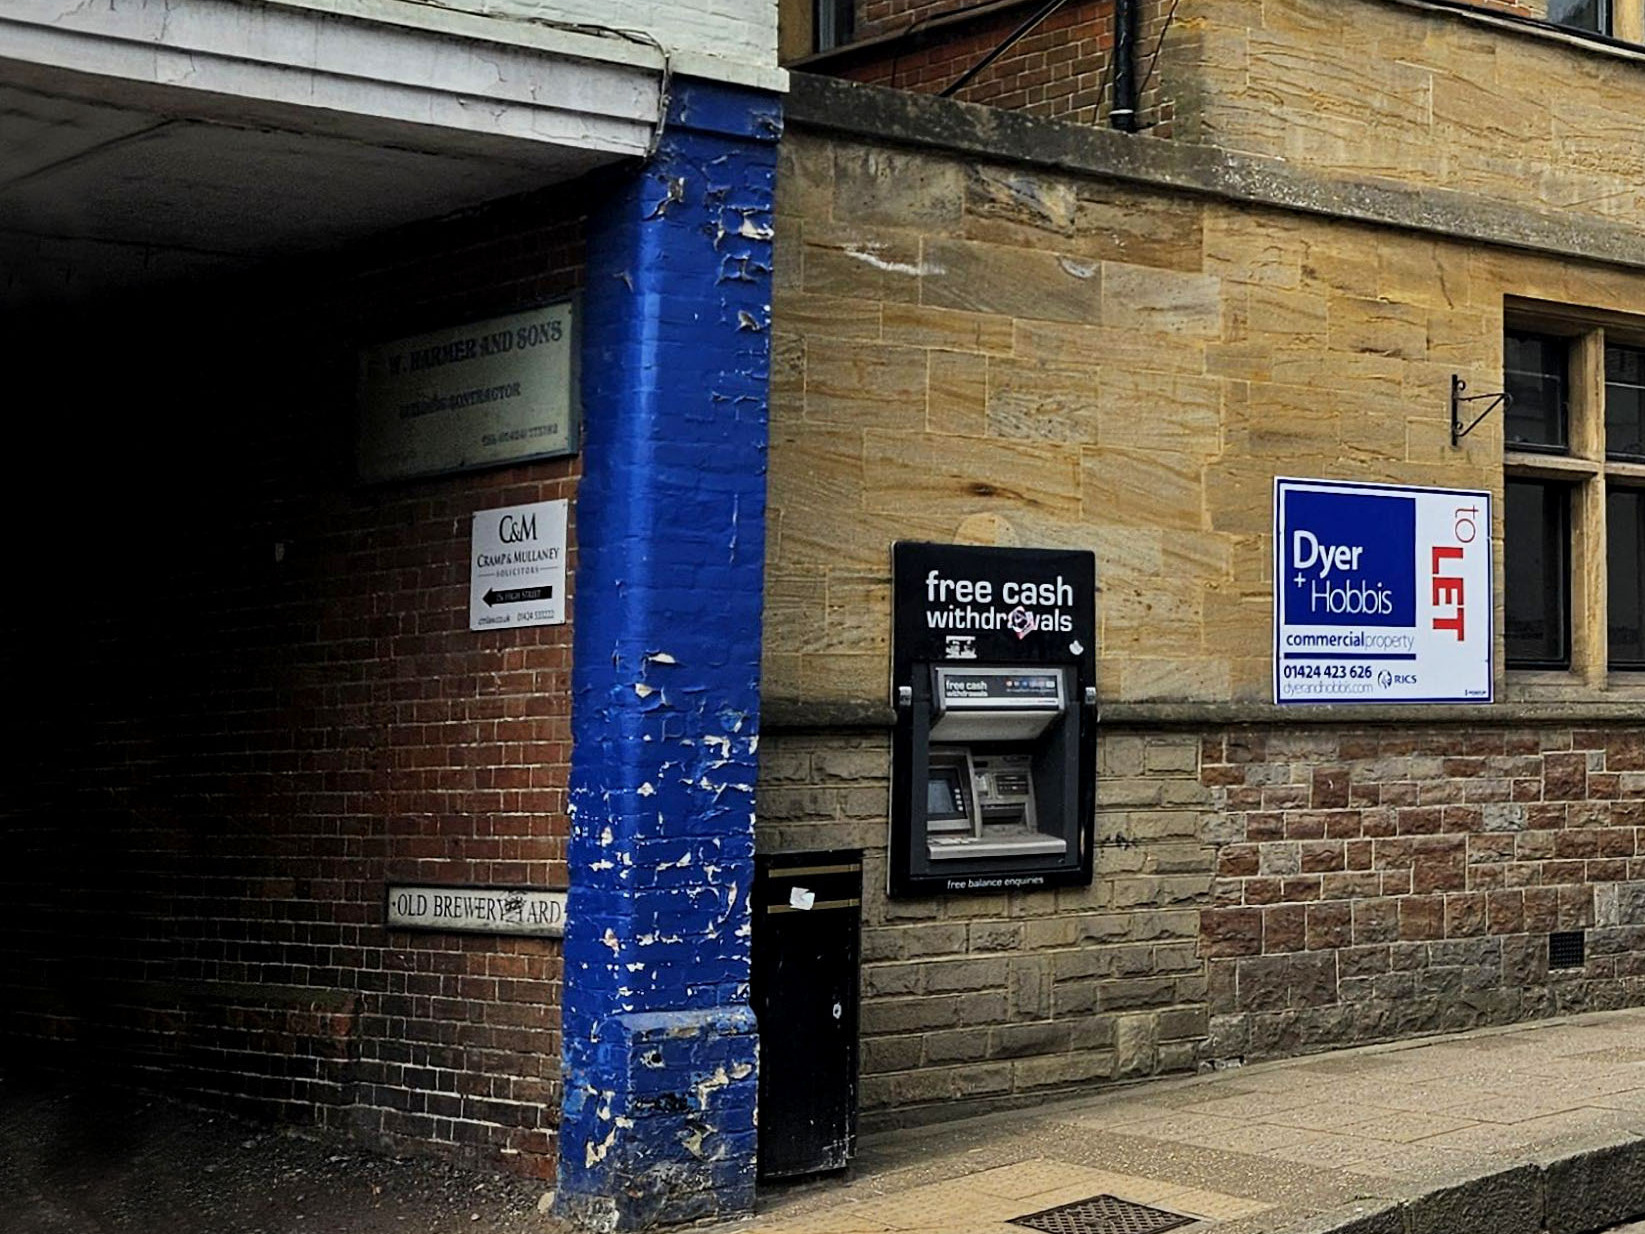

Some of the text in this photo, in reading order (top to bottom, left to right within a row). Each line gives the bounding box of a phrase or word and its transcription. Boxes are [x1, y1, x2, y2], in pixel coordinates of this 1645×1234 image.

[480, 330, 514, 358] AND
[516, 320, 563, 351] SONS
[499, 512, 538, 544] C&M
[513, 547, 560, 564] MULLANEY
[1293, 530, 1363, 579] Dyer
[496, 566, 539, 577] SOLICITORS
[926, 570, 1074, 607] free cash
[1311, 579, 1393, 615] Hobbis
[1432, 546, 1465, 642] LET
[926, 605, 1073, 633] withdrals
[1284, 665, 1372, 679] 01424 423 626
[1394, 674, 1417, 685] RICS
[947, 876, 1044, 890] free balance enquiries
[397, 893, 428, 917] OLD
[434, 895, 506, 921] BREWERY
